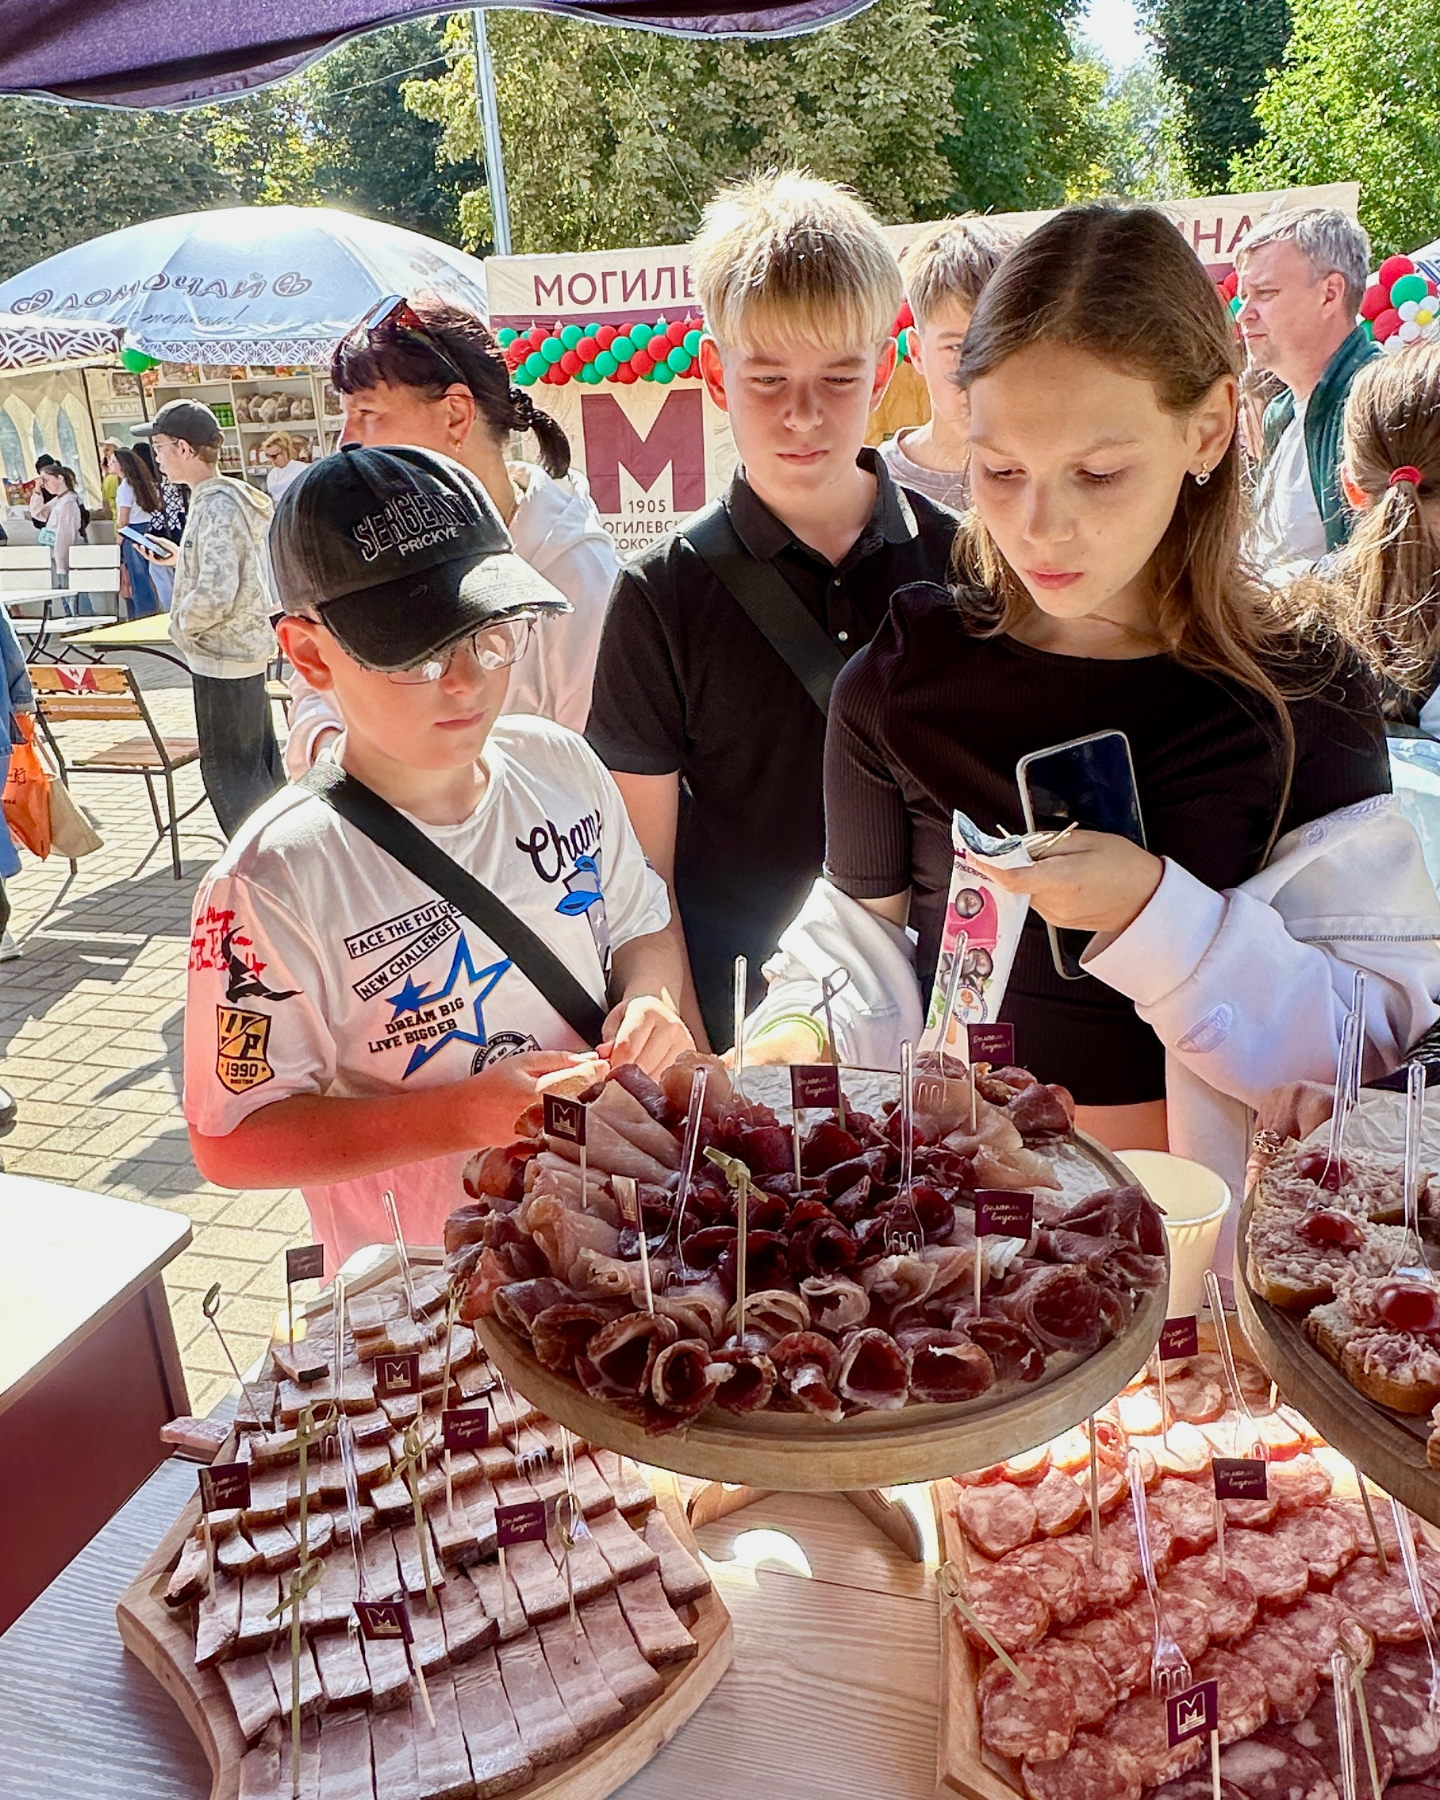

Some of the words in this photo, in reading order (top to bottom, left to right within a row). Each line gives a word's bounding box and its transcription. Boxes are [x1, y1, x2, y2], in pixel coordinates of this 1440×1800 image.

[533, 265, 696, 306] МОГИЛЕ
[628, 499, 667, 514] 1905
[602, 520, 678, 535] ОГИЛЕВС
[350, 931, 386, 956] FACE
[385, 919, 414, 938] THE
[359, 971, 389, 998] NEW
[389, 919, 454, 976] CHALLENGE
[439, 997, 465, 1016] BIG
[368, 1035, 403, 1053] LIVE
[225, 1062, 259, 1078] 1990
